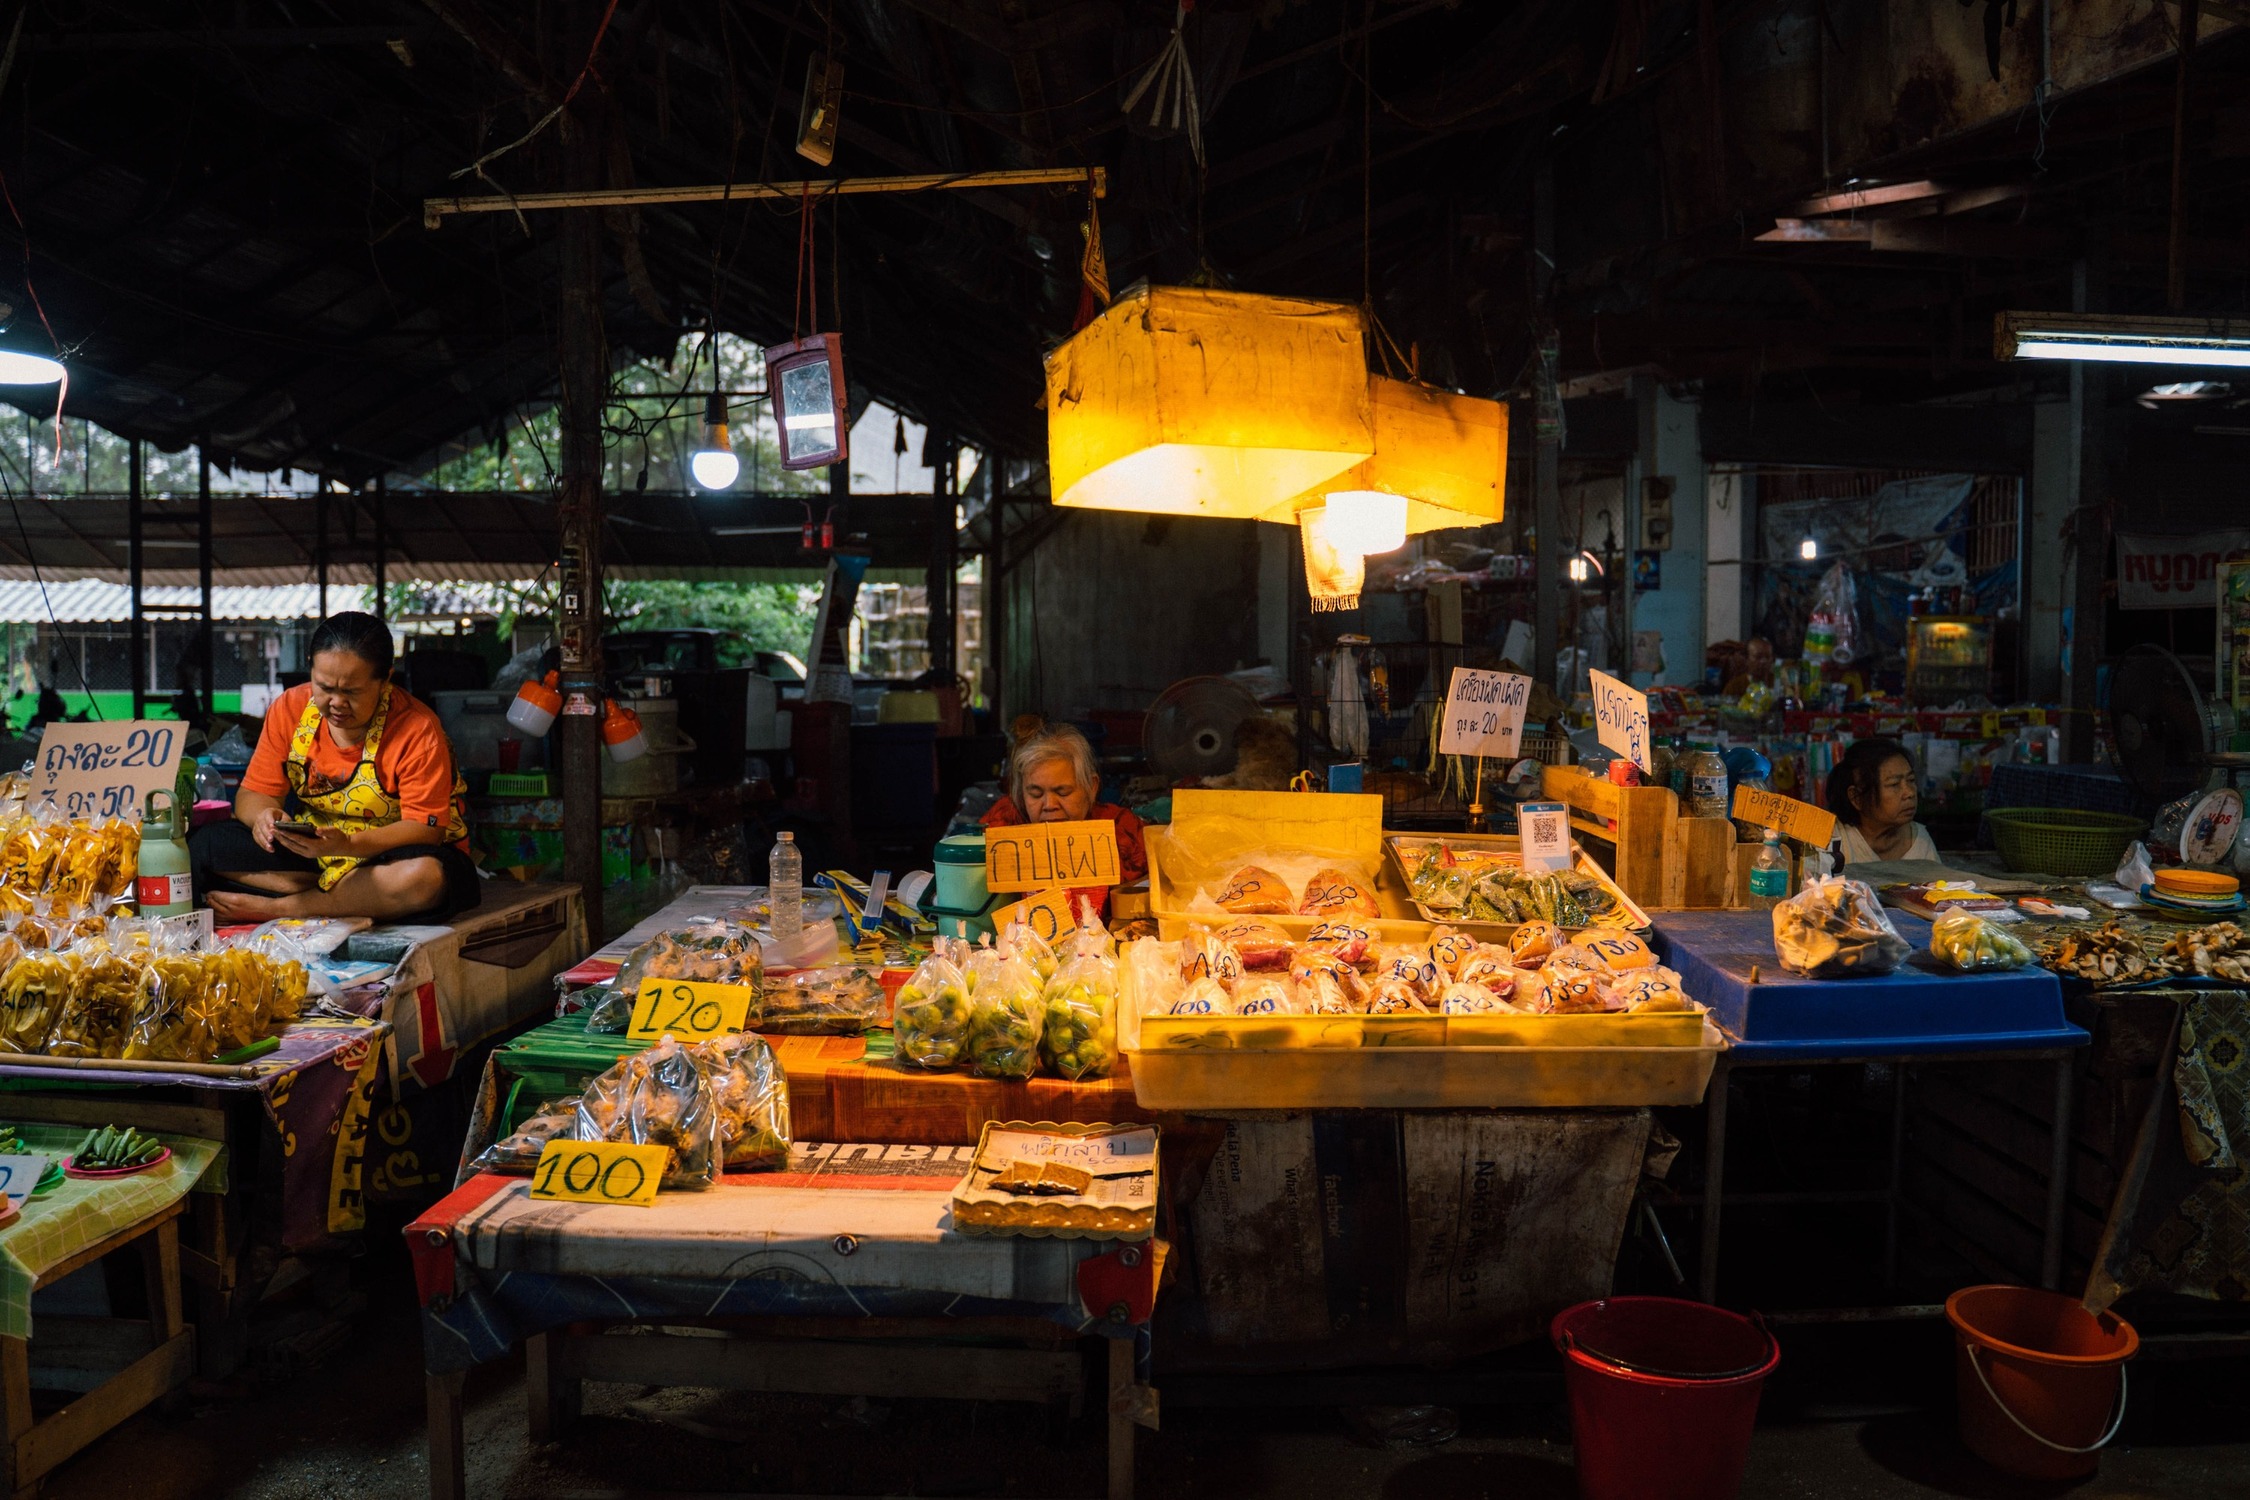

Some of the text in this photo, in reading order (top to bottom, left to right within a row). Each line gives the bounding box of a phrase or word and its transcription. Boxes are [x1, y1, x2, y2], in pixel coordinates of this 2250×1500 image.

[1482, 712, 1498, 735] 20
[121, 728, 173, 767] 20
[1541, 978, 1588, 1005] 130
[1323, 1174, 1344, 1239] facebook
[1470, 1160, 1496, 1221] Nokia
